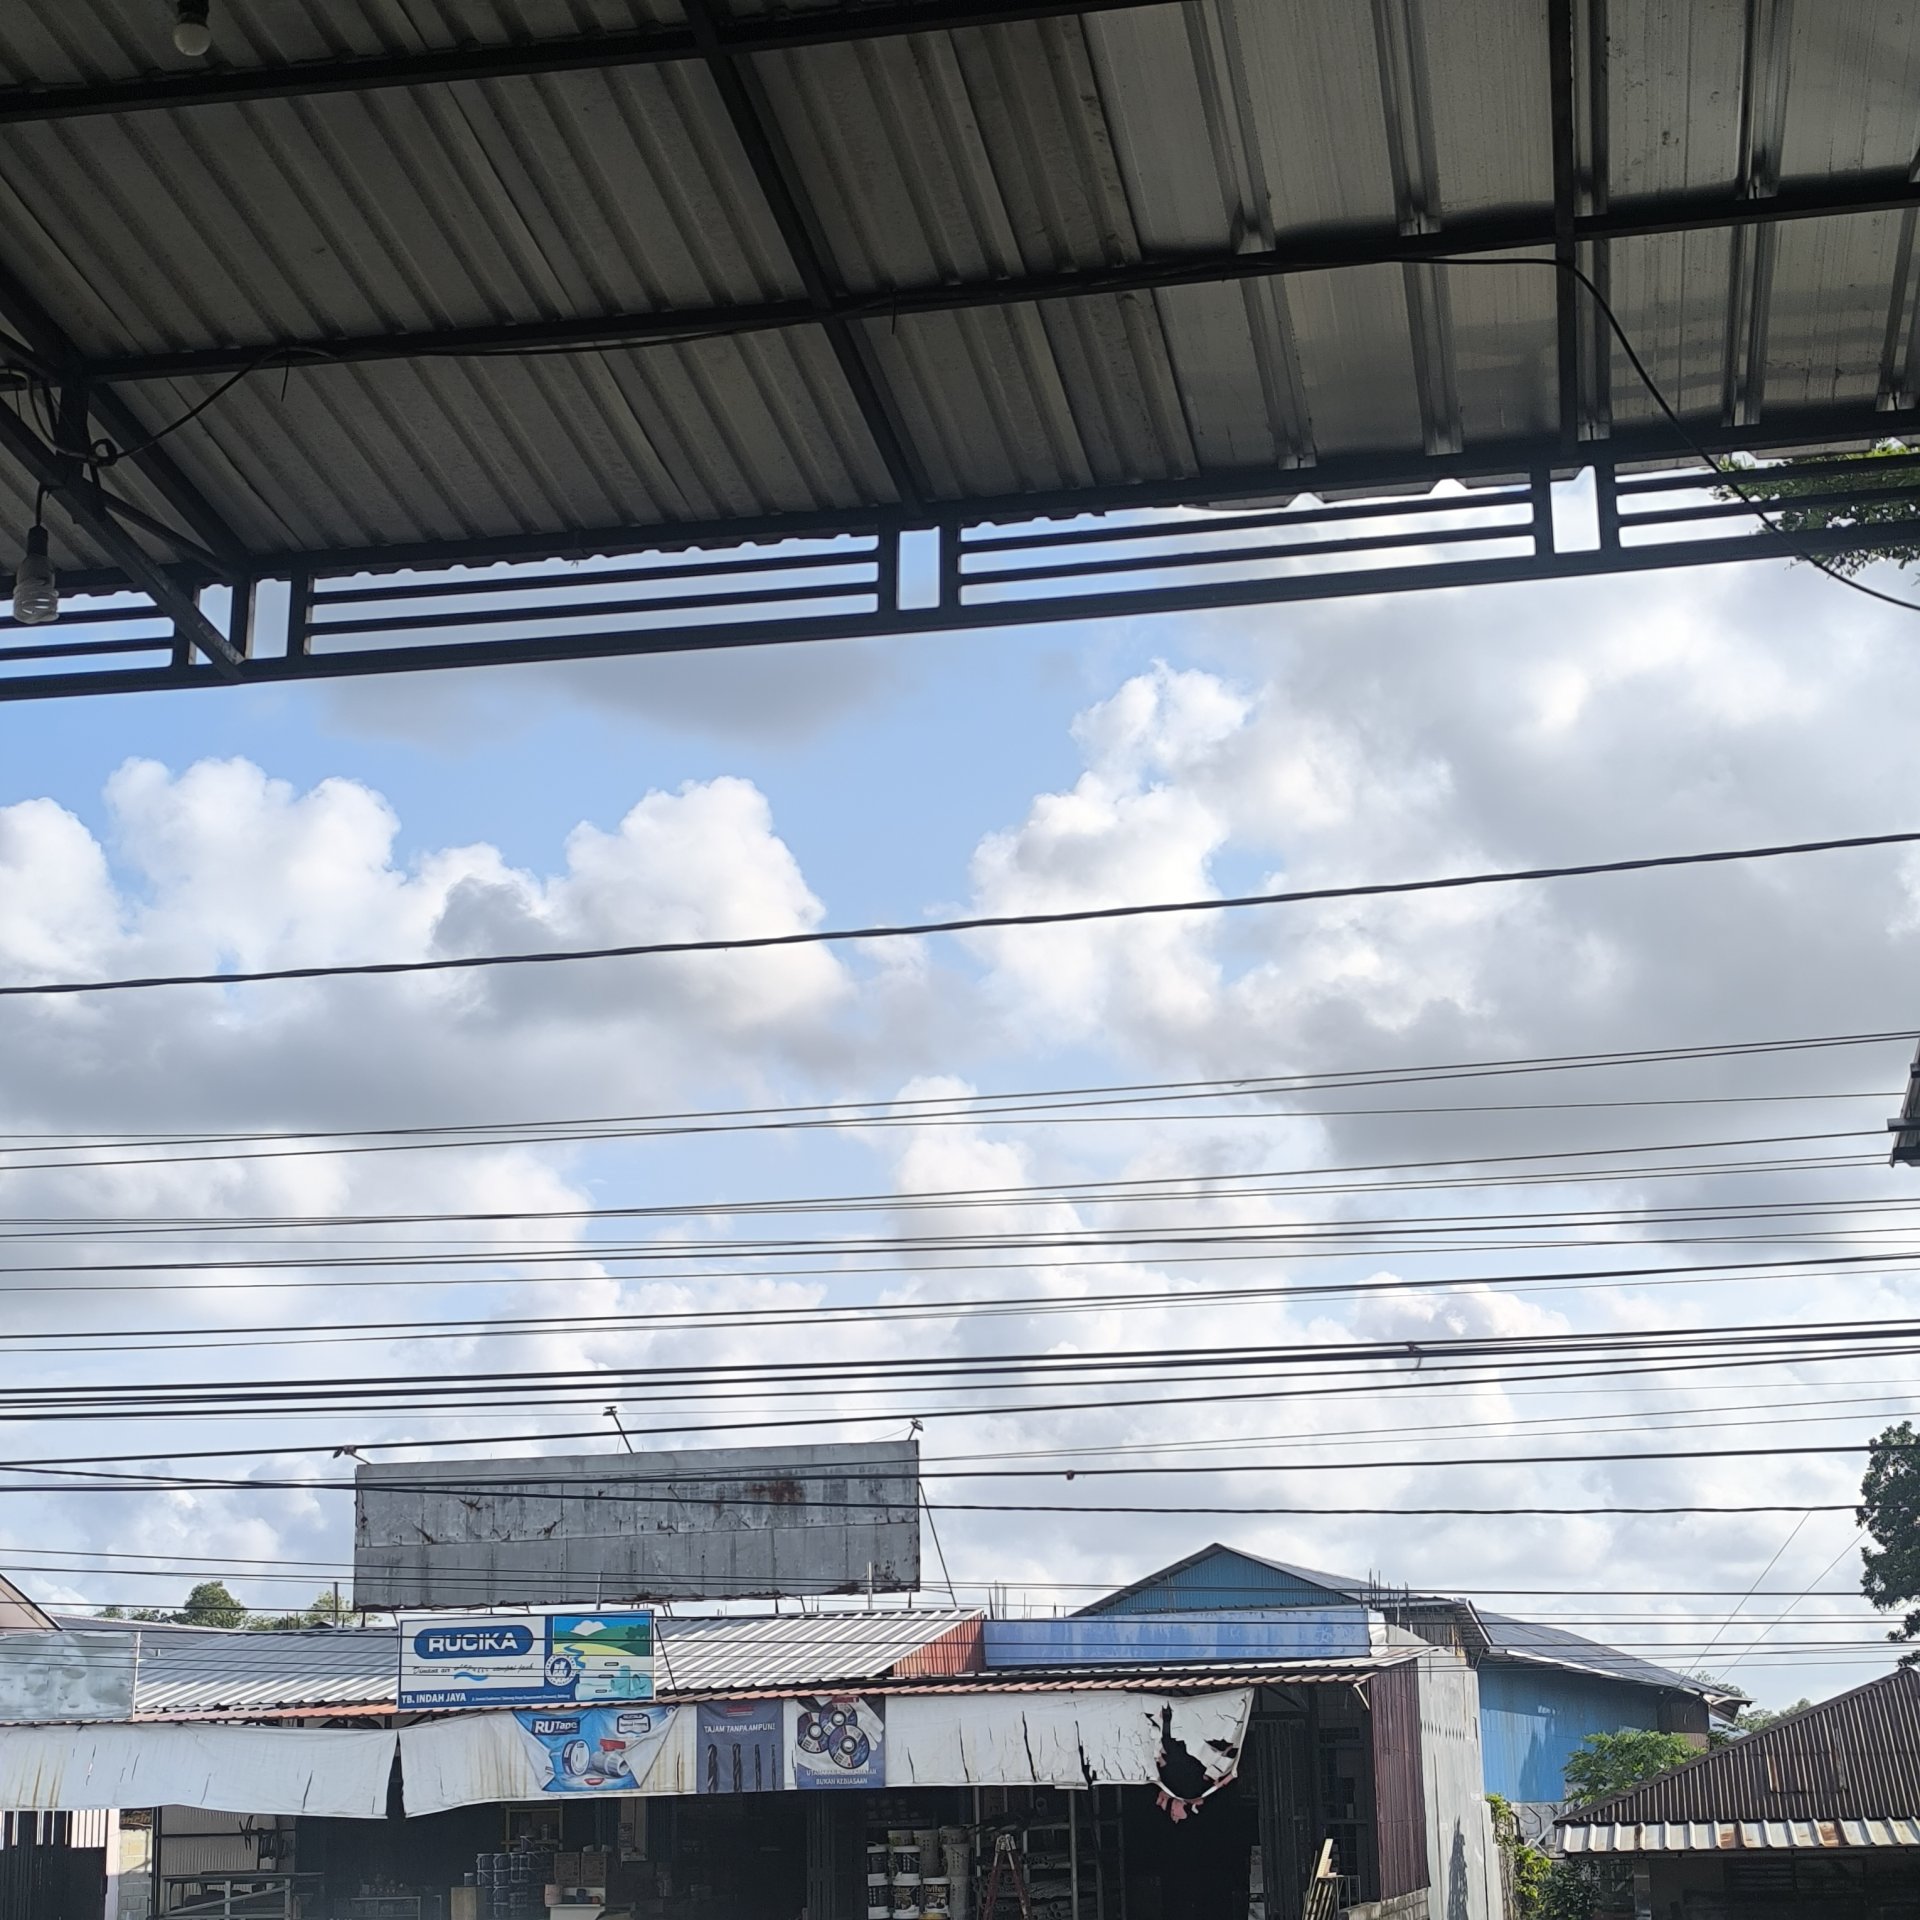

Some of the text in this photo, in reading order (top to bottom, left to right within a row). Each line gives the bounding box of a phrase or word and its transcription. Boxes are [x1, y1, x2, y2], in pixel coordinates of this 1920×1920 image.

[428, 1632, 518, 1653] RUCIKA
[401, 1695, 415, 1704] TB.
[416, 1693, 445, 1703] INDAH
[446, 1692, 467, 1702] JAYA
[703, 1724, 725, 1733] TAJAM
[726, 1723, 748, 1733] TANPA
